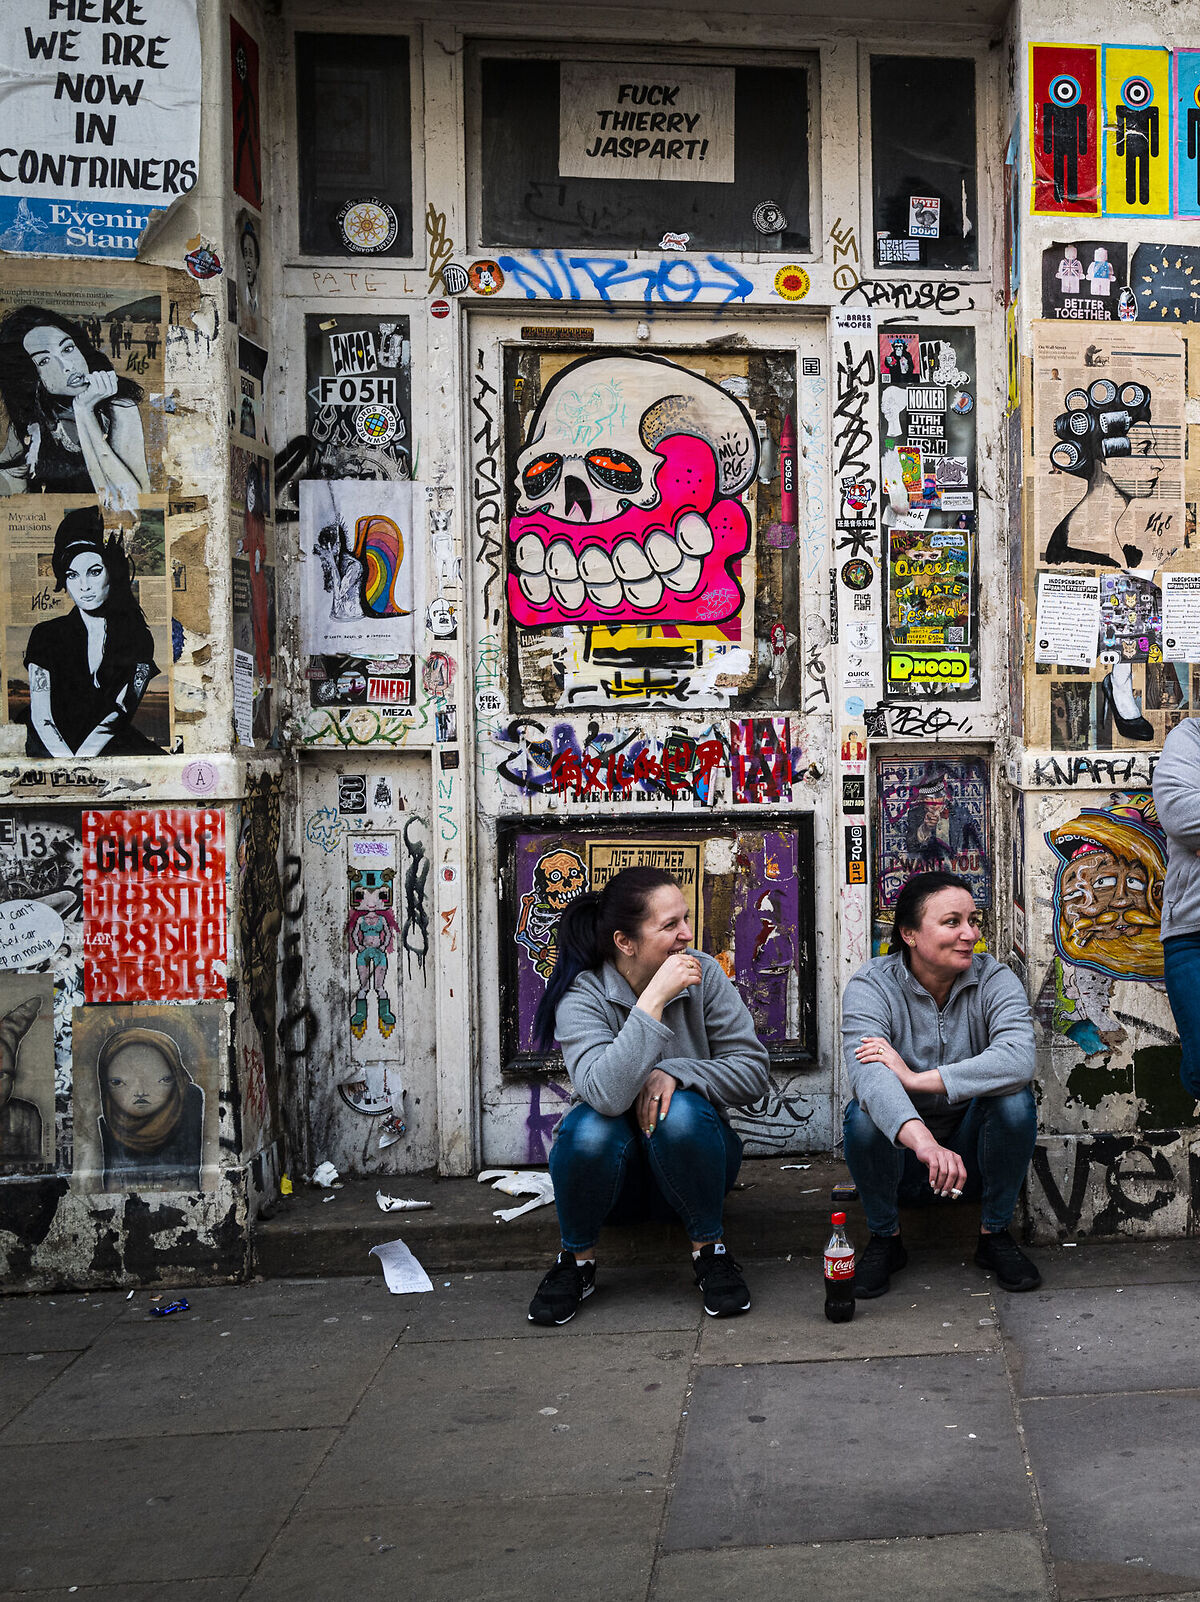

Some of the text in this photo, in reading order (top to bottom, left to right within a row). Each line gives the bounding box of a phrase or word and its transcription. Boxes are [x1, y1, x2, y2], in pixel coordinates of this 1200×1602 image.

[49, 0, 147, 26] HERE
[24, 27, 170, 69] WE ARE
[54, 72, 144, 106] NOW
[617, 84, 680, 106] FUCK
[75, 112, 117, 146] IN
[597, 110, 701, 133] THIERRY
[586, 136, 709, 161] JASPART!
[0, 148, 198, 194] CONTAINERS
[49, 204, 149, 229] Evenin
[66, 227, 140, 250] Stan
[911, 226, 937, 236] DODO
[1064, 298, 1104, 310] BETTER
[1055, 308, 1112, 321] TOGETHER
[909, 389, 945, 409] NOKIER
[358, 406, 395, 444] RECORDS GLOBE TOWN
[912, 414, 941, 425] UTAH
[908, 426, 944, 435] ETHER
[895, 560, 951, 576] Queer
[895, 585, 962, 599] CLIMATE
[382, 708, 413, 717] MEZA
[487, 702, 501, 710] EAT
[20, 832, 47, 858] 13
[608, 850, 635, 867] JUST
[950, 854, 980, 872] YOU
[23, 939, 55, 958] moving
